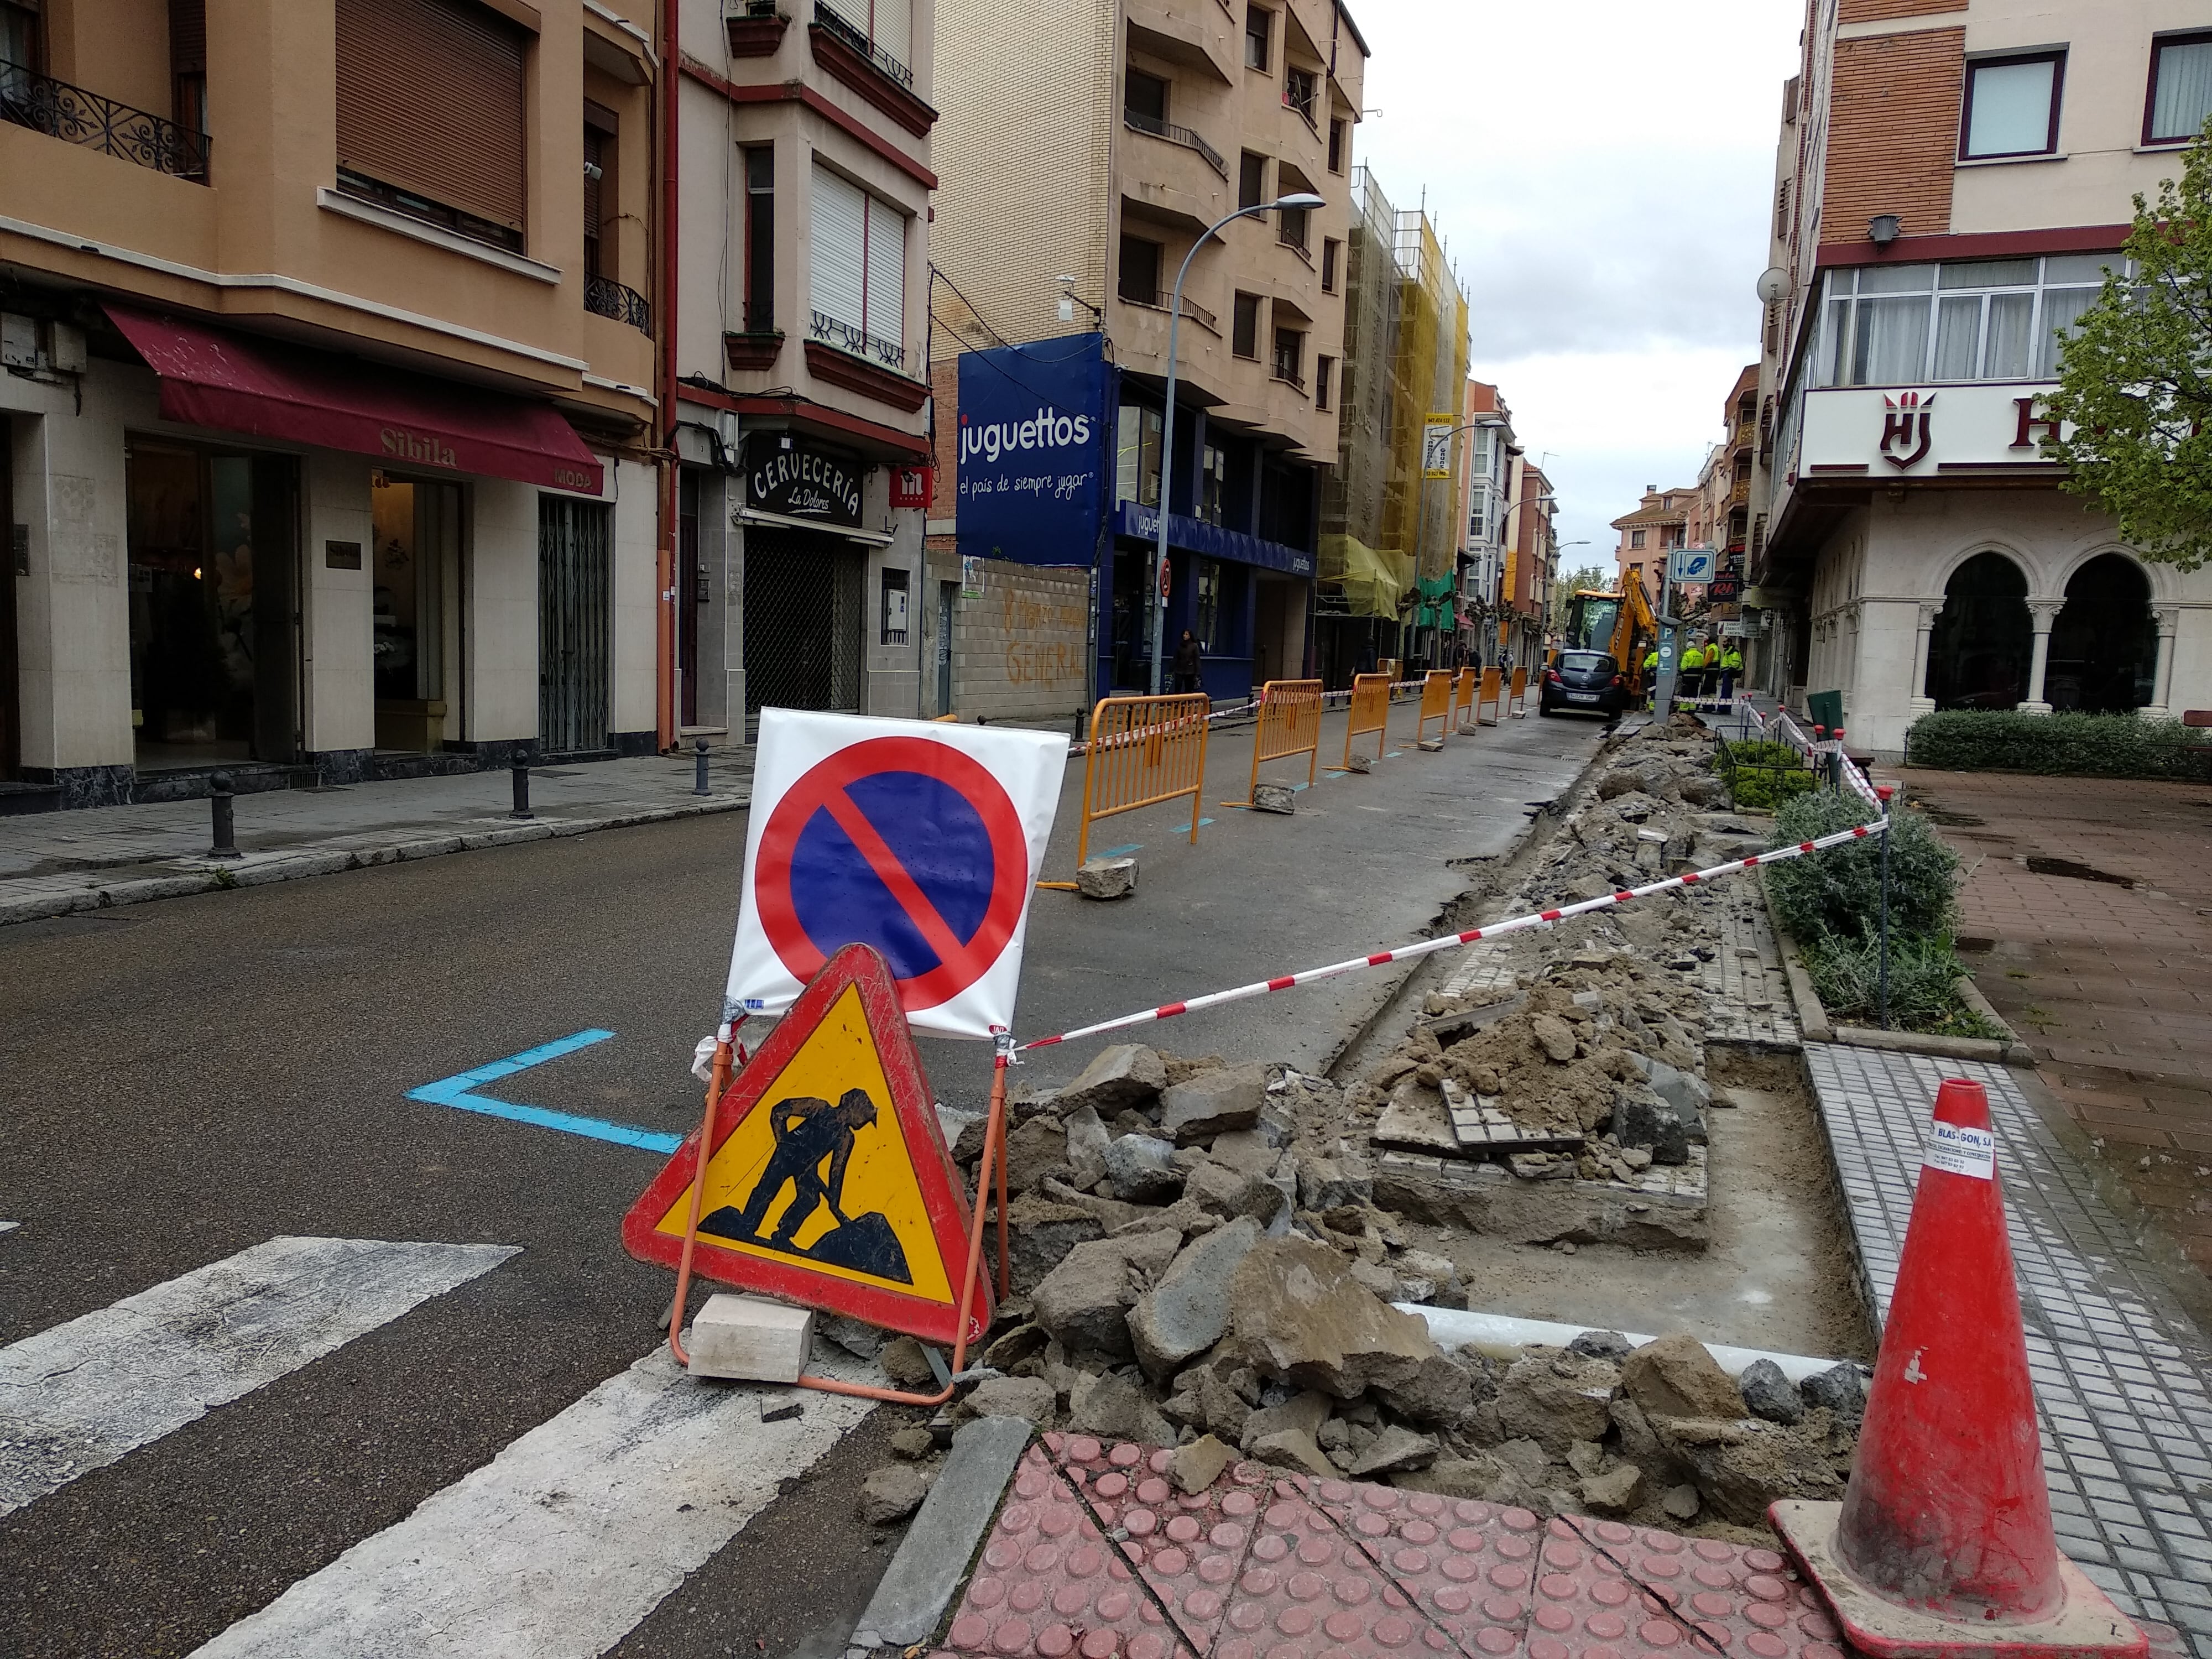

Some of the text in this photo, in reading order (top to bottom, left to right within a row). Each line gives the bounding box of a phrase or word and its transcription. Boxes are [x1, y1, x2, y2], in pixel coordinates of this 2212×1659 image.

[380, 428, 456, 467] Sibila
[961, 406, 1090, 465] juguettos
[555, 468, 593, 489] MODA
[754, 453, 858, 517] CERVECERÍA
[960, 476, 968, 494] el
[972, 477, 993, 502] país
[997, 473, 1010, 492] de
[1014, 475, 1053, 498] siempre
[788, 487, 830, 510] La Dolores
[1664, 628, 1673, 639] P
